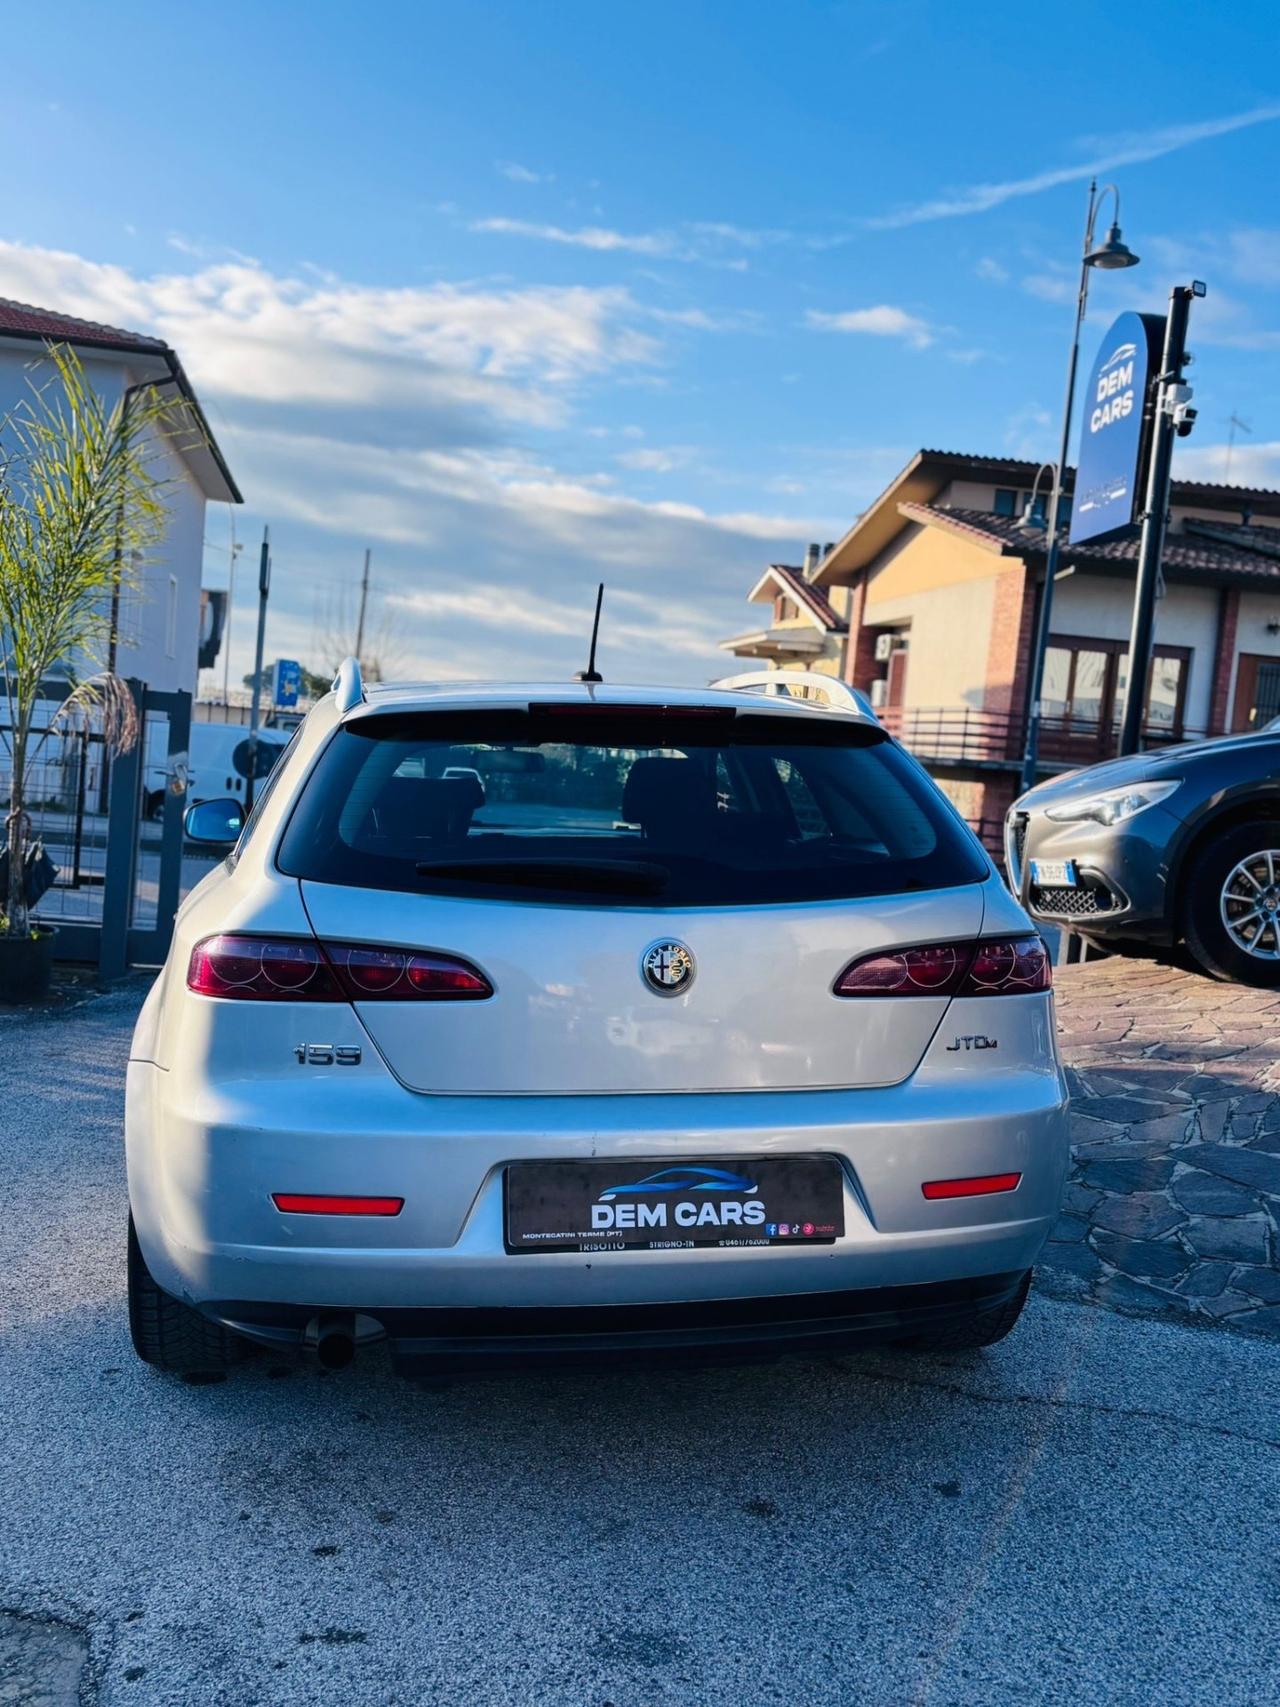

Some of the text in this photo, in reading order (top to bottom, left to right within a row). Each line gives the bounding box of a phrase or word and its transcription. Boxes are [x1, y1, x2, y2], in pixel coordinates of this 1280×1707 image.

[1097, 361, 1133, 402] DEM
[1091, 391, 1134, 433] CARS
[293, 1043, 362, 1065] 159
[591, 1200, 766, 1229] DEM CARS
[522, 1232, 576, 1240] MONTECATINI
[606, 1230, 623, 1238] (PT)
